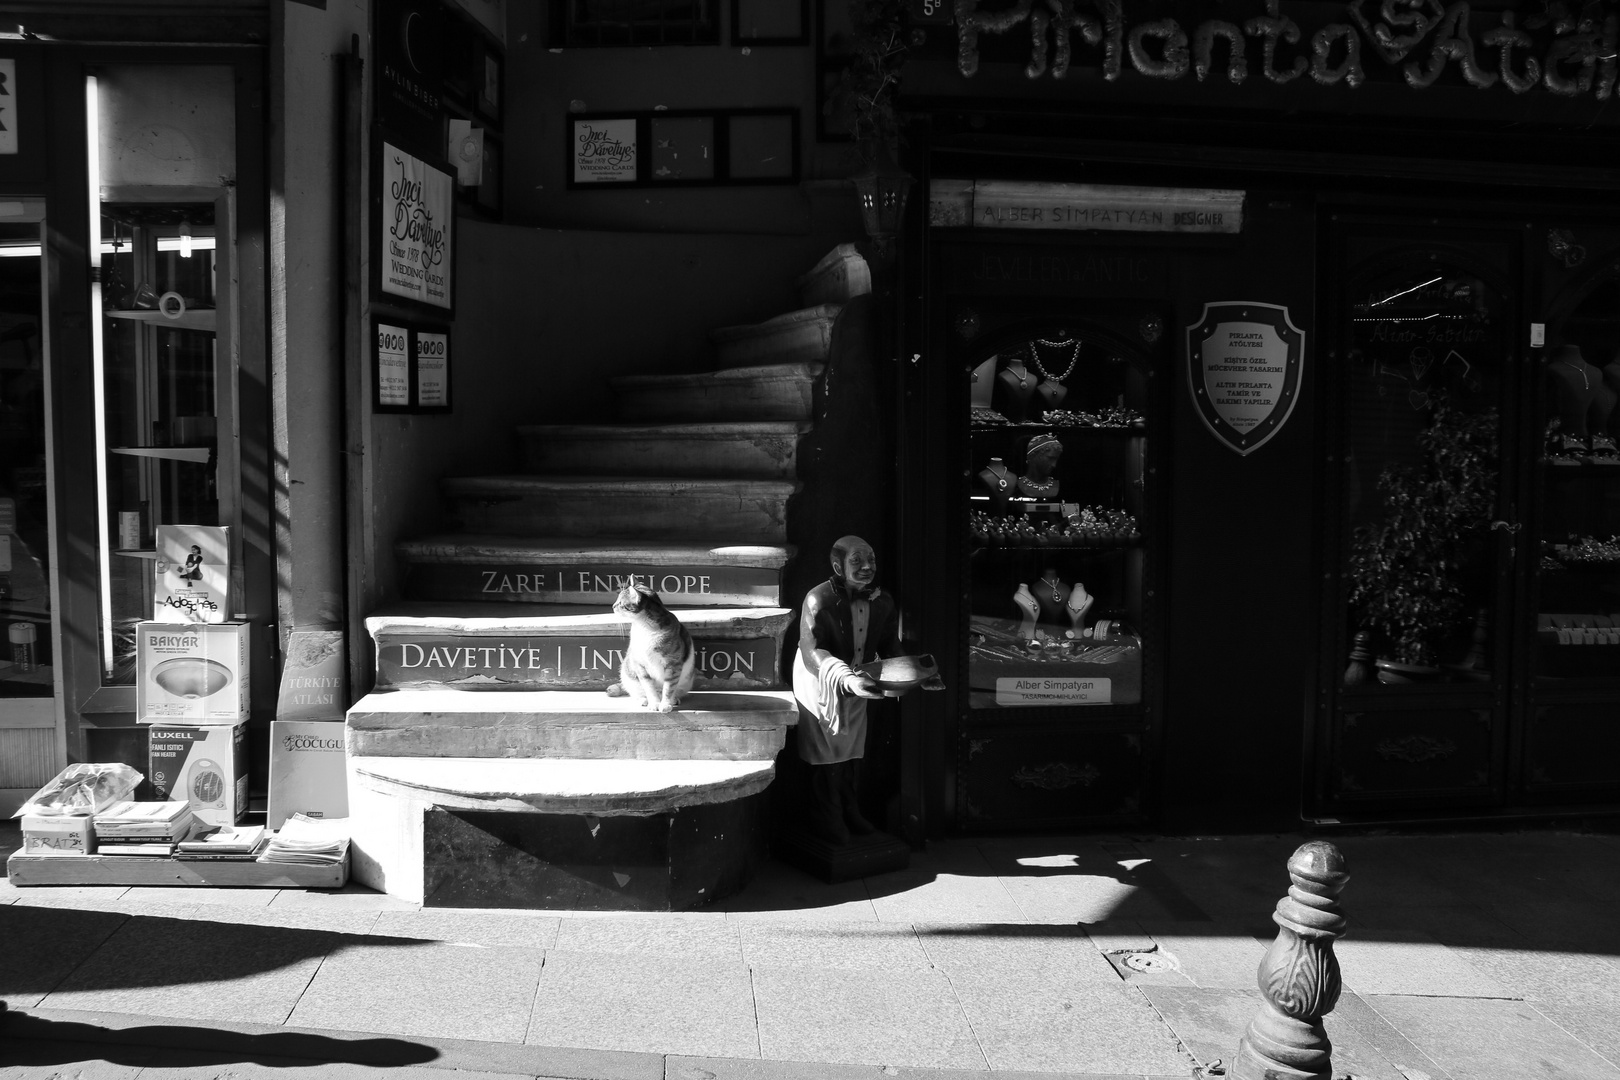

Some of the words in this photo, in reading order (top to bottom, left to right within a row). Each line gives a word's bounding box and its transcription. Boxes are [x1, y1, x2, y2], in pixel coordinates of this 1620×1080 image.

[391, 259, 424, 281] WEDDING
[481, 570, 545, 594] ZARF
[149, 635, 199, 648] BAKYAR
[288, 675, 341, 689] TÜRKİYE
[1015, 680, 1041, 690] Alber
[1043, 680, 1094, 692] Simpatyan
[290, 694, 334, 705] ATLASI
